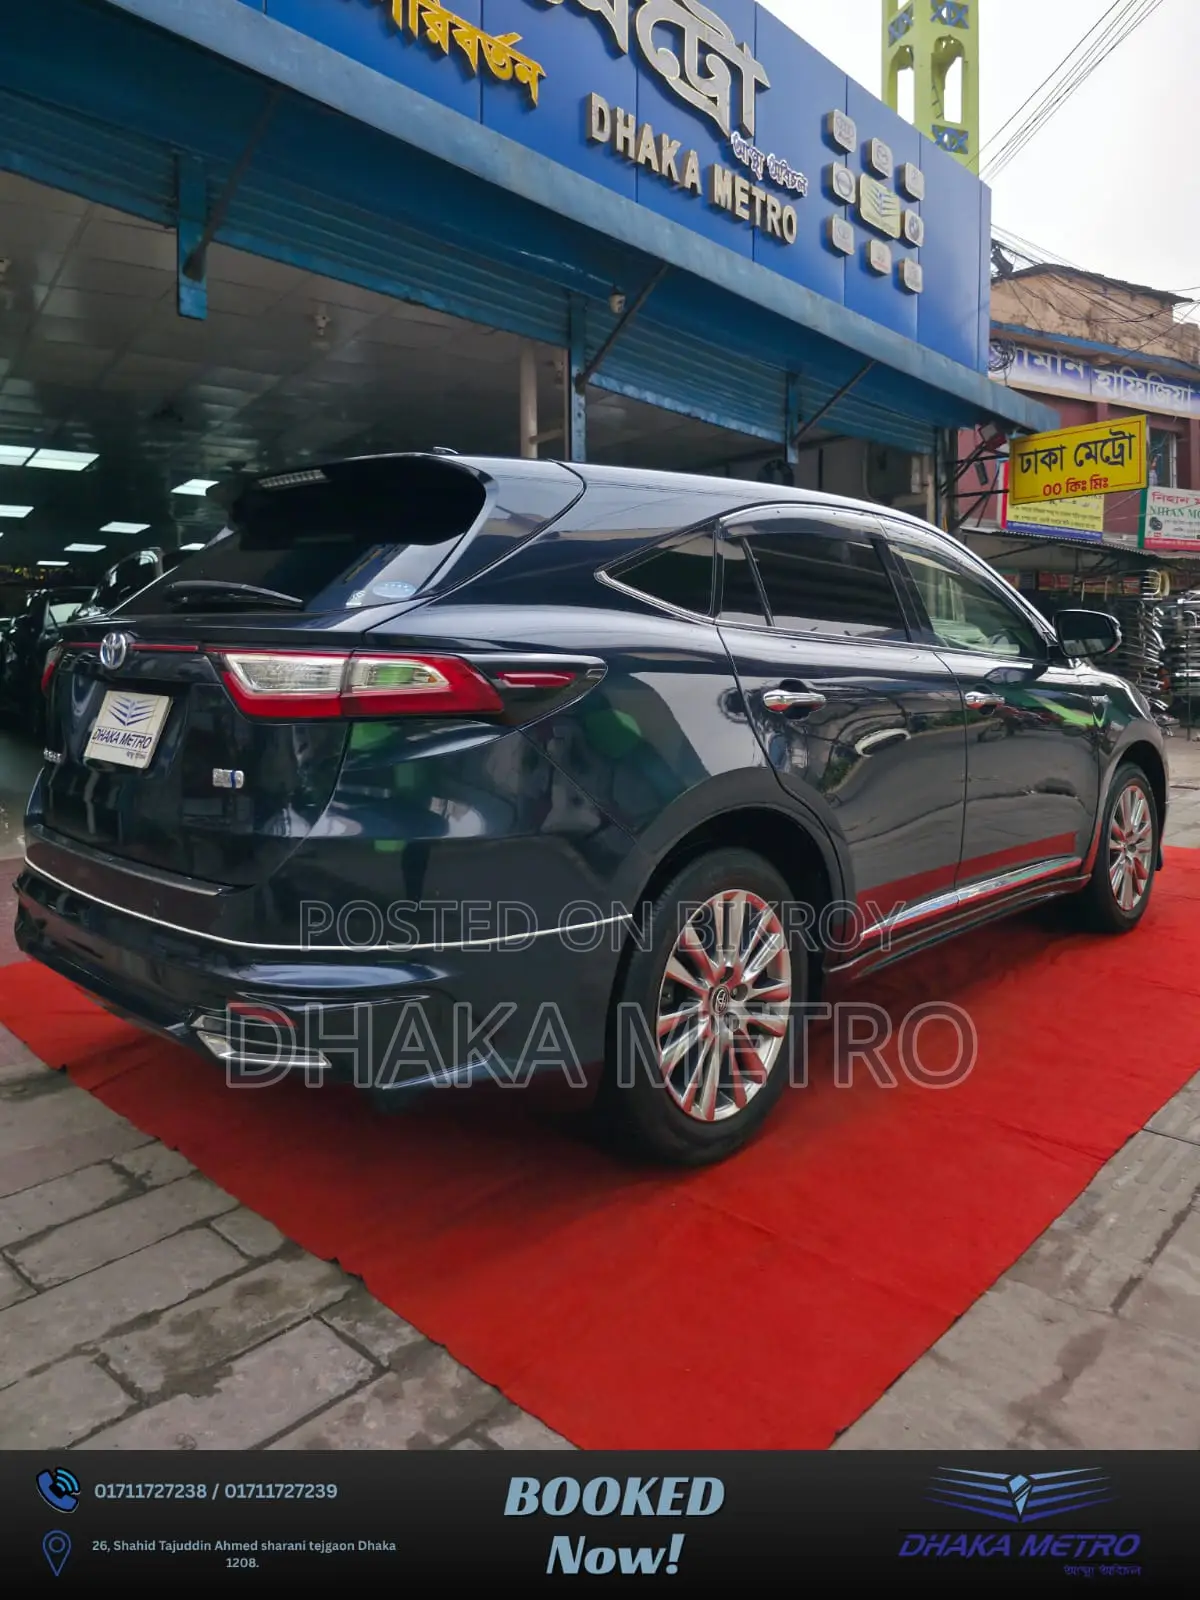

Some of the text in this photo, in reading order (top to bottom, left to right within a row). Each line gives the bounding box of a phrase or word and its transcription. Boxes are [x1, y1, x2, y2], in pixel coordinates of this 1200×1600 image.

[586, 92, 797, 245] DHAKA METRO
[1017, 428, 1136, 475] ঢাকা মেট্রো
[92, 728, 153, 749] DHAKA METRO
